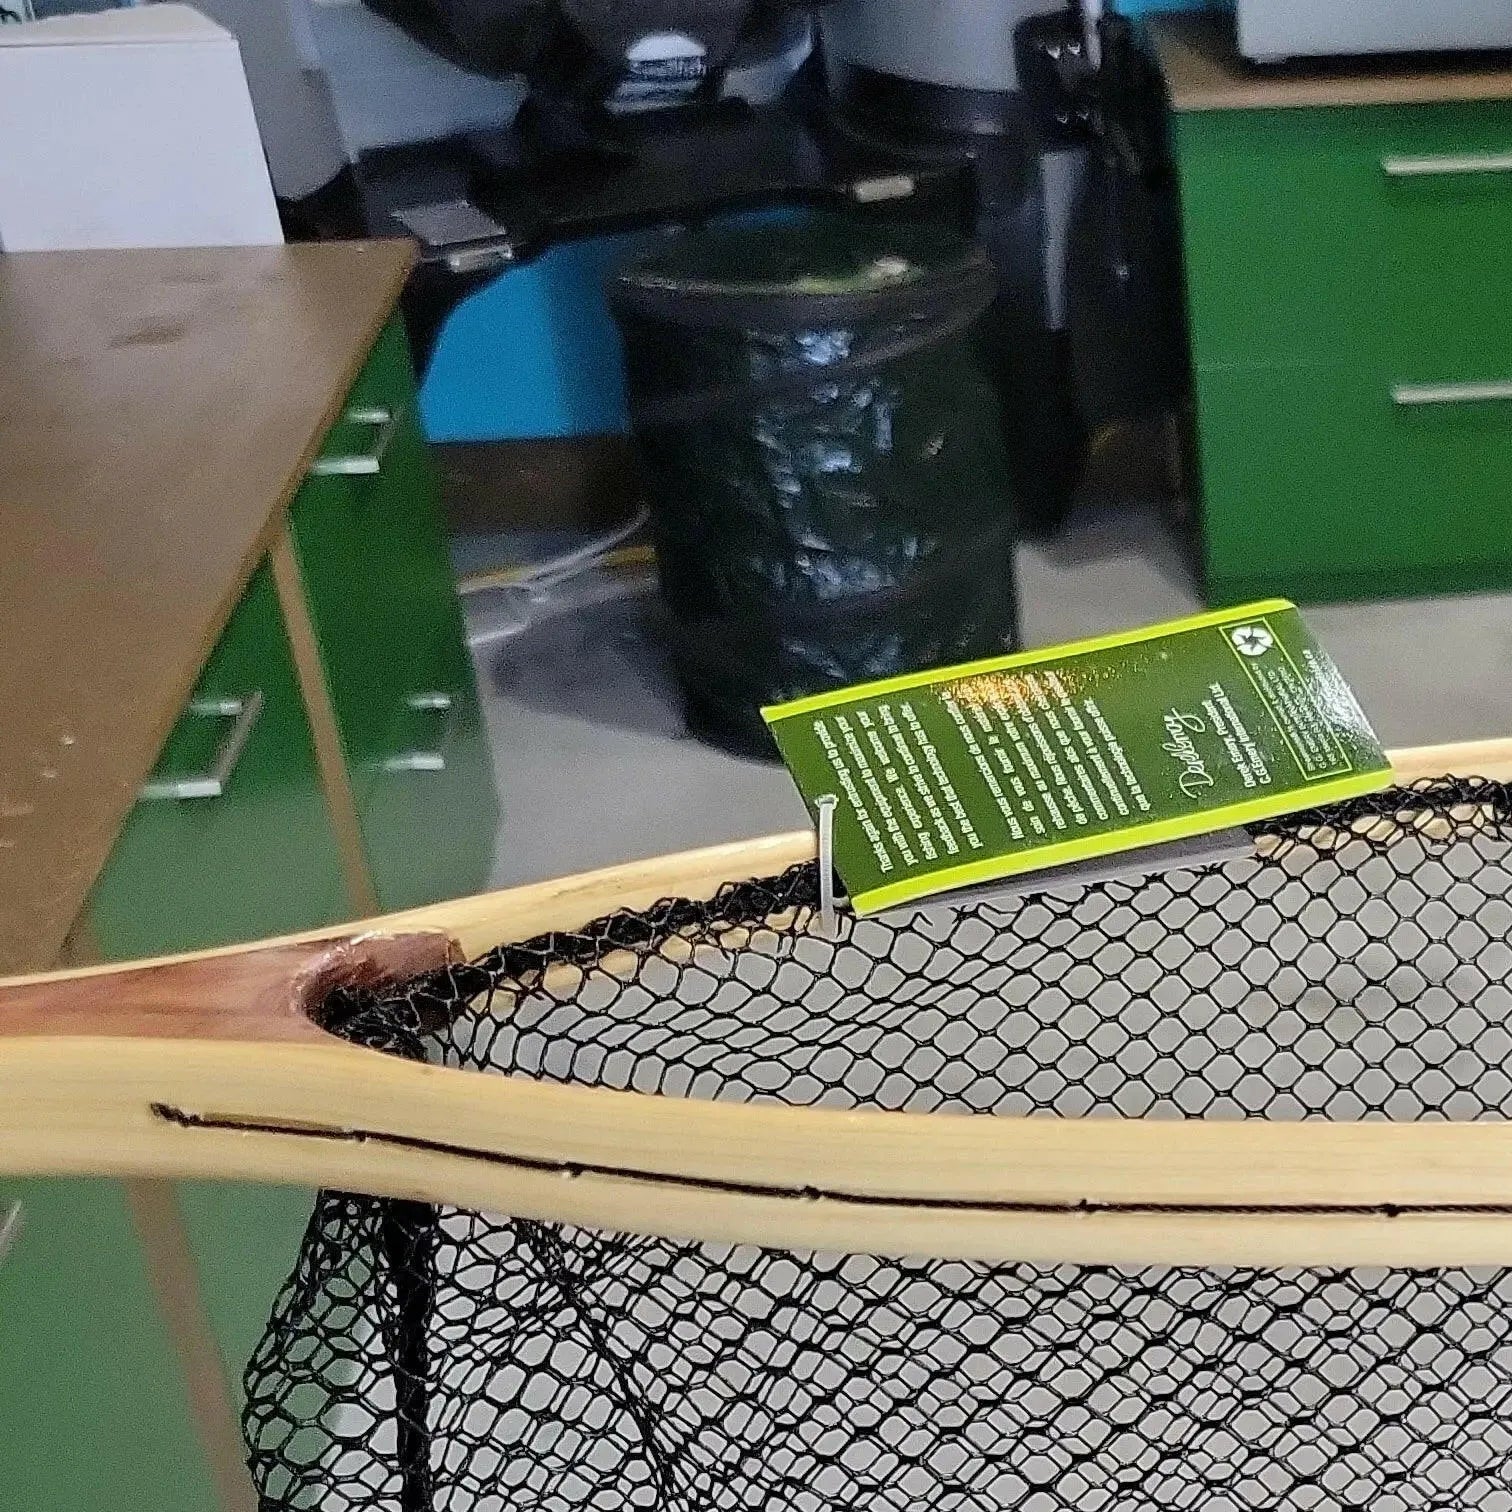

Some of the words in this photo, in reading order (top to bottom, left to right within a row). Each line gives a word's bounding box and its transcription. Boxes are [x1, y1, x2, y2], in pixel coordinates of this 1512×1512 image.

[941, 690, 952, 700] le
[1060, 697, 1071, 706] le
[834, 715, 853, 733] your
[856, 710, 874, 728] your
[878, 704, 894, 725] bring
[1044, 710, 1061, 729] nous
[1064, 706, 1084, 730] fournir
[1201, 699, 1228, 735] President
[1216, 696, 1249, 742] International
[813, 720, 836, 749] provide
[887, 724, 899, 733] to
[909, 720, 921, 730] to
[958, 724, 975, 743] nous
[1003, 721, 1020, 741] votre
[1094, 716, 1116, 741] puisse
[914, 729, 928, 745] has
[988, 735, 999, 744] le
[1055, 730, 1071, 745] que
[827, 748, 838, 758] to
[844, 732, 868, 768] maximize
[867, 730, 890, 764] welcome
[891, 732, 915, 765] continue
[968, 743, 981, 754] de
[1085, 746, 1097, 754] à
[831, 757, 844, 769] us
[907, 764, 919, 774] to
[922, 744, 948, 785] technology
[994, 748, 1014, 773] fournir
[1015, 741, 1040, 779] maximum
[1107, 741, 1136, 785] technologie
[861, 768, 872, 778] to
[885, 767, 899, 782] We
[974, 754, 1002, 797] remercions
[1050, 764, 1067, 785] Nous
[1236, 761, 1256, 787] Derek
[837, 768, 862, 807] entrusting
[912, 773, 930, 795] strive
[940, 784, 957, 801] that
[1009, 776, 1026, 796] vous
[1035, 779, 1047, 791] au
[1074, 764, 1108, 819] commentaires
[1089, 753, 1128, 815] continuellement
[1130, 784, 1141, 794] la
[864, 777, 892, 817] equipment
[922, 794, 936, 808] we
[1021, 799, 1034, 811] de
[1135, 793, 1151, 810] que
[855, 807, 868, 820] for
[929, 806, 942, 818] as
[948, 800, 966, 819] best
[996, 797, 1013, 817] vous
[1041, 792, 1066, 829] rehausse
[885, 817, 899, 832] the
[959, 818, 973, 833] the
[1006, 816, 1024, 839] Nous
[1029, 815, 1045, 834] soin
[1074, 812, 1087, 824] de
[861, 819, 880, 842] again
[891, 831, 908, 849] with
[934, 817, 958, 854] feedback
[966, 832, 983, 848] you
[917, 831, 937, 859] fishing
[872, 841, 893, 872] Thanks
[901, 848, 918, 865] you
